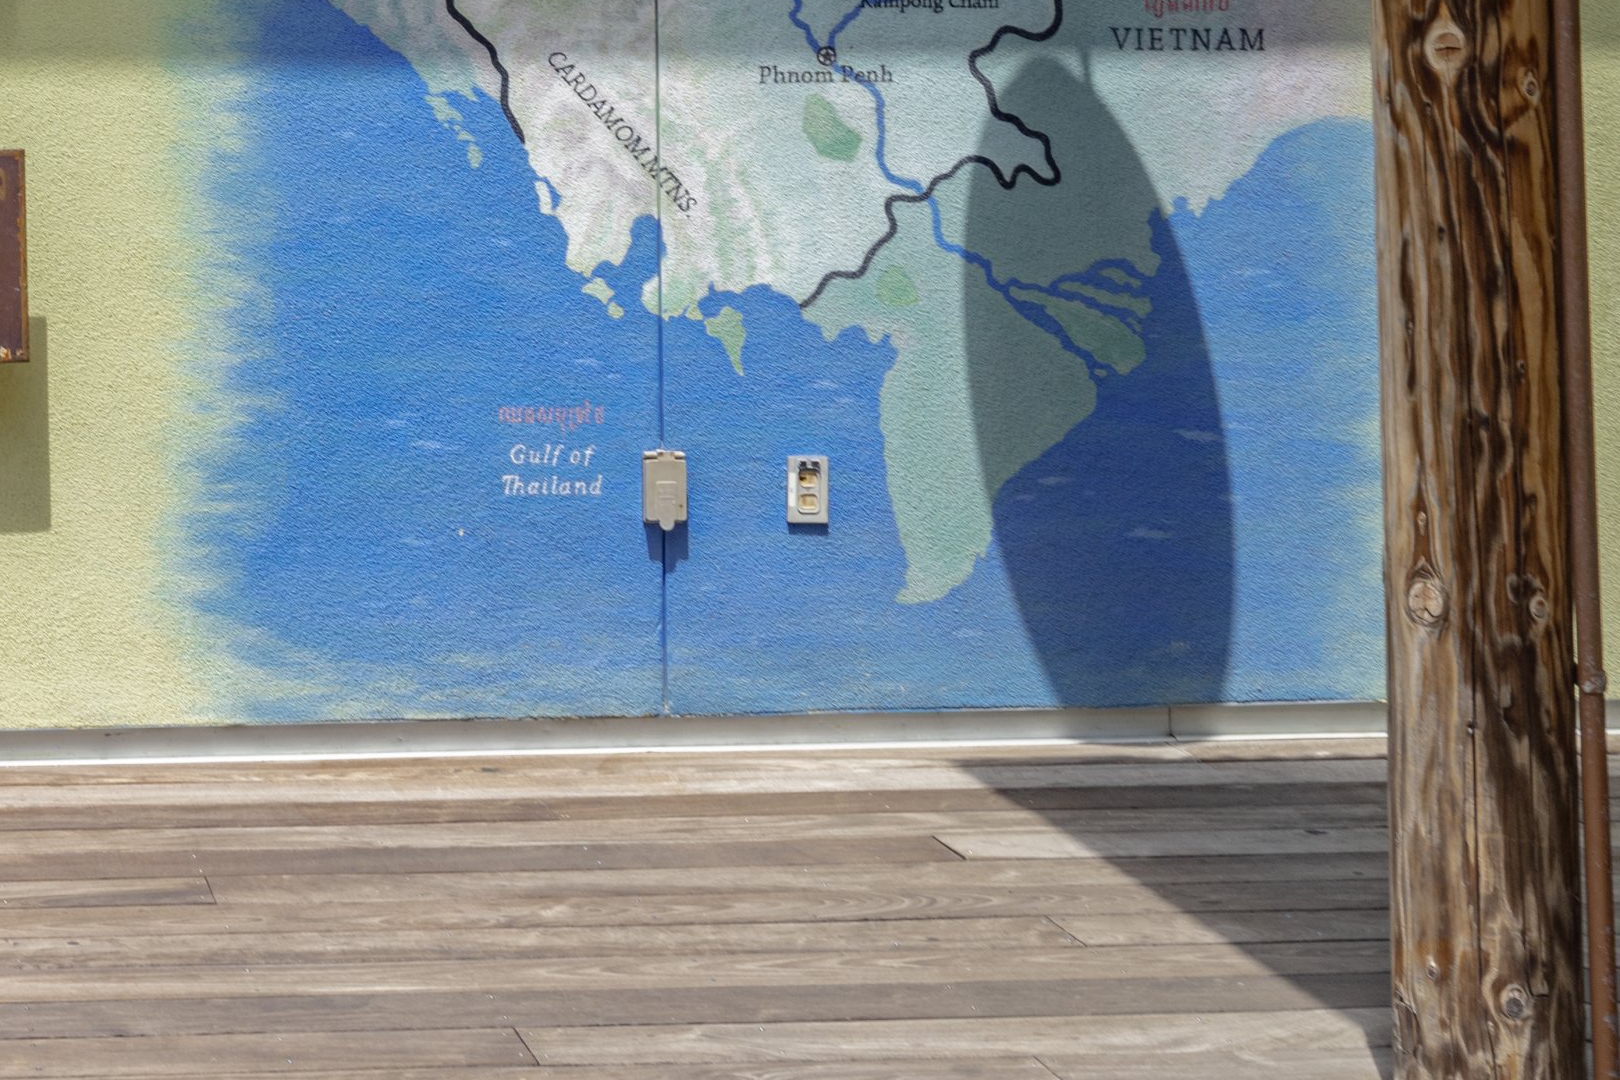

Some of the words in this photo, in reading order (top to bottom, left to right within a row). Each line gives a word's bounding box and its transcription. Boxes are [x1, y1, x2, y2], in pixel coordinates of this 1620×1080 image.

[1109, 27, 1265, 51] VIETNAM
[759, 65, 832, 85] Phnom
[841, 65, 893, 83] Penh
[548, 52, 651, 162] CARDAMOM
[641, 156, 698, 218] MTNS.
[510, 444, 564, 467] Gulf
[570, 443, 596, 466] of
[502, 474, 604, 497] Thailand
